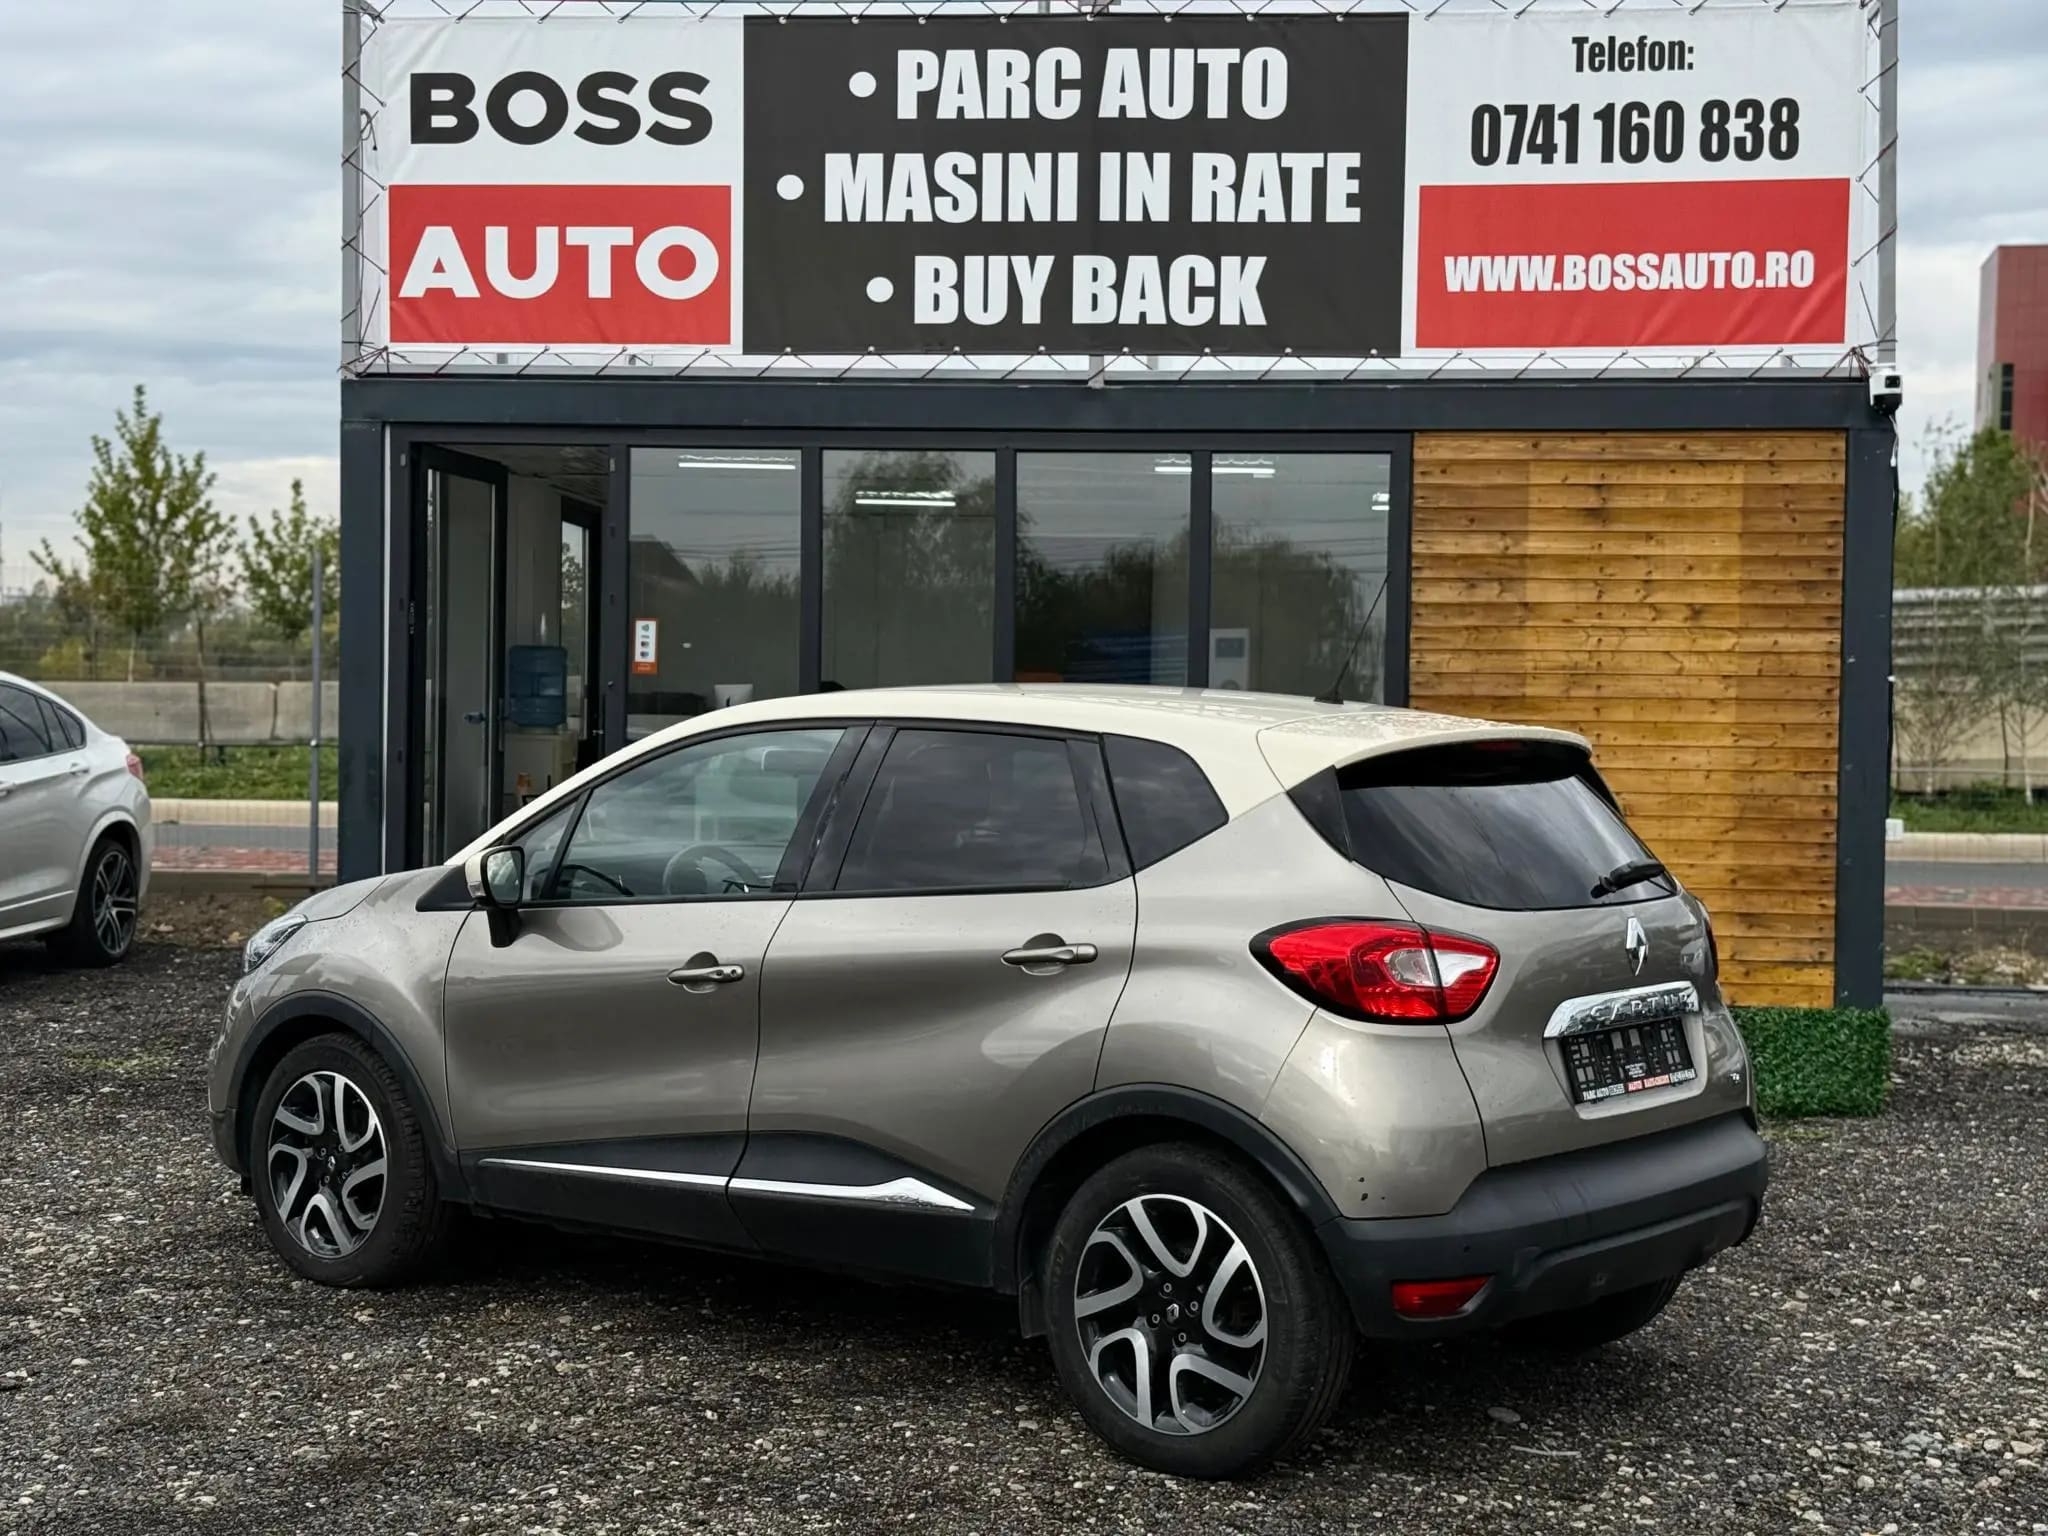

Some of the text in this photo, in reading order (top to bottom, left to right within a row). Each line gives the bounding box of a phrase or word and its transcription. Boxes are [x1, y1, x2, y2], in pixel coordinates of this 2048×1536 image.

[898, 47, 1287, 119] PARC AUTO
[1572, 36, 1693, 72] Telefon:
[411, 72, 712, 145] BOSS
[1472, 98, 1799, 166] 0741 160 838
[825, 152, 1360, 223] MASINI IN RATE
[399, 226, 719, 299] AUTO
[915, 255, 1267, 326] BUY BACK
[1445, 251, 1814, 291] WWW.BOSSAUTO.RO
